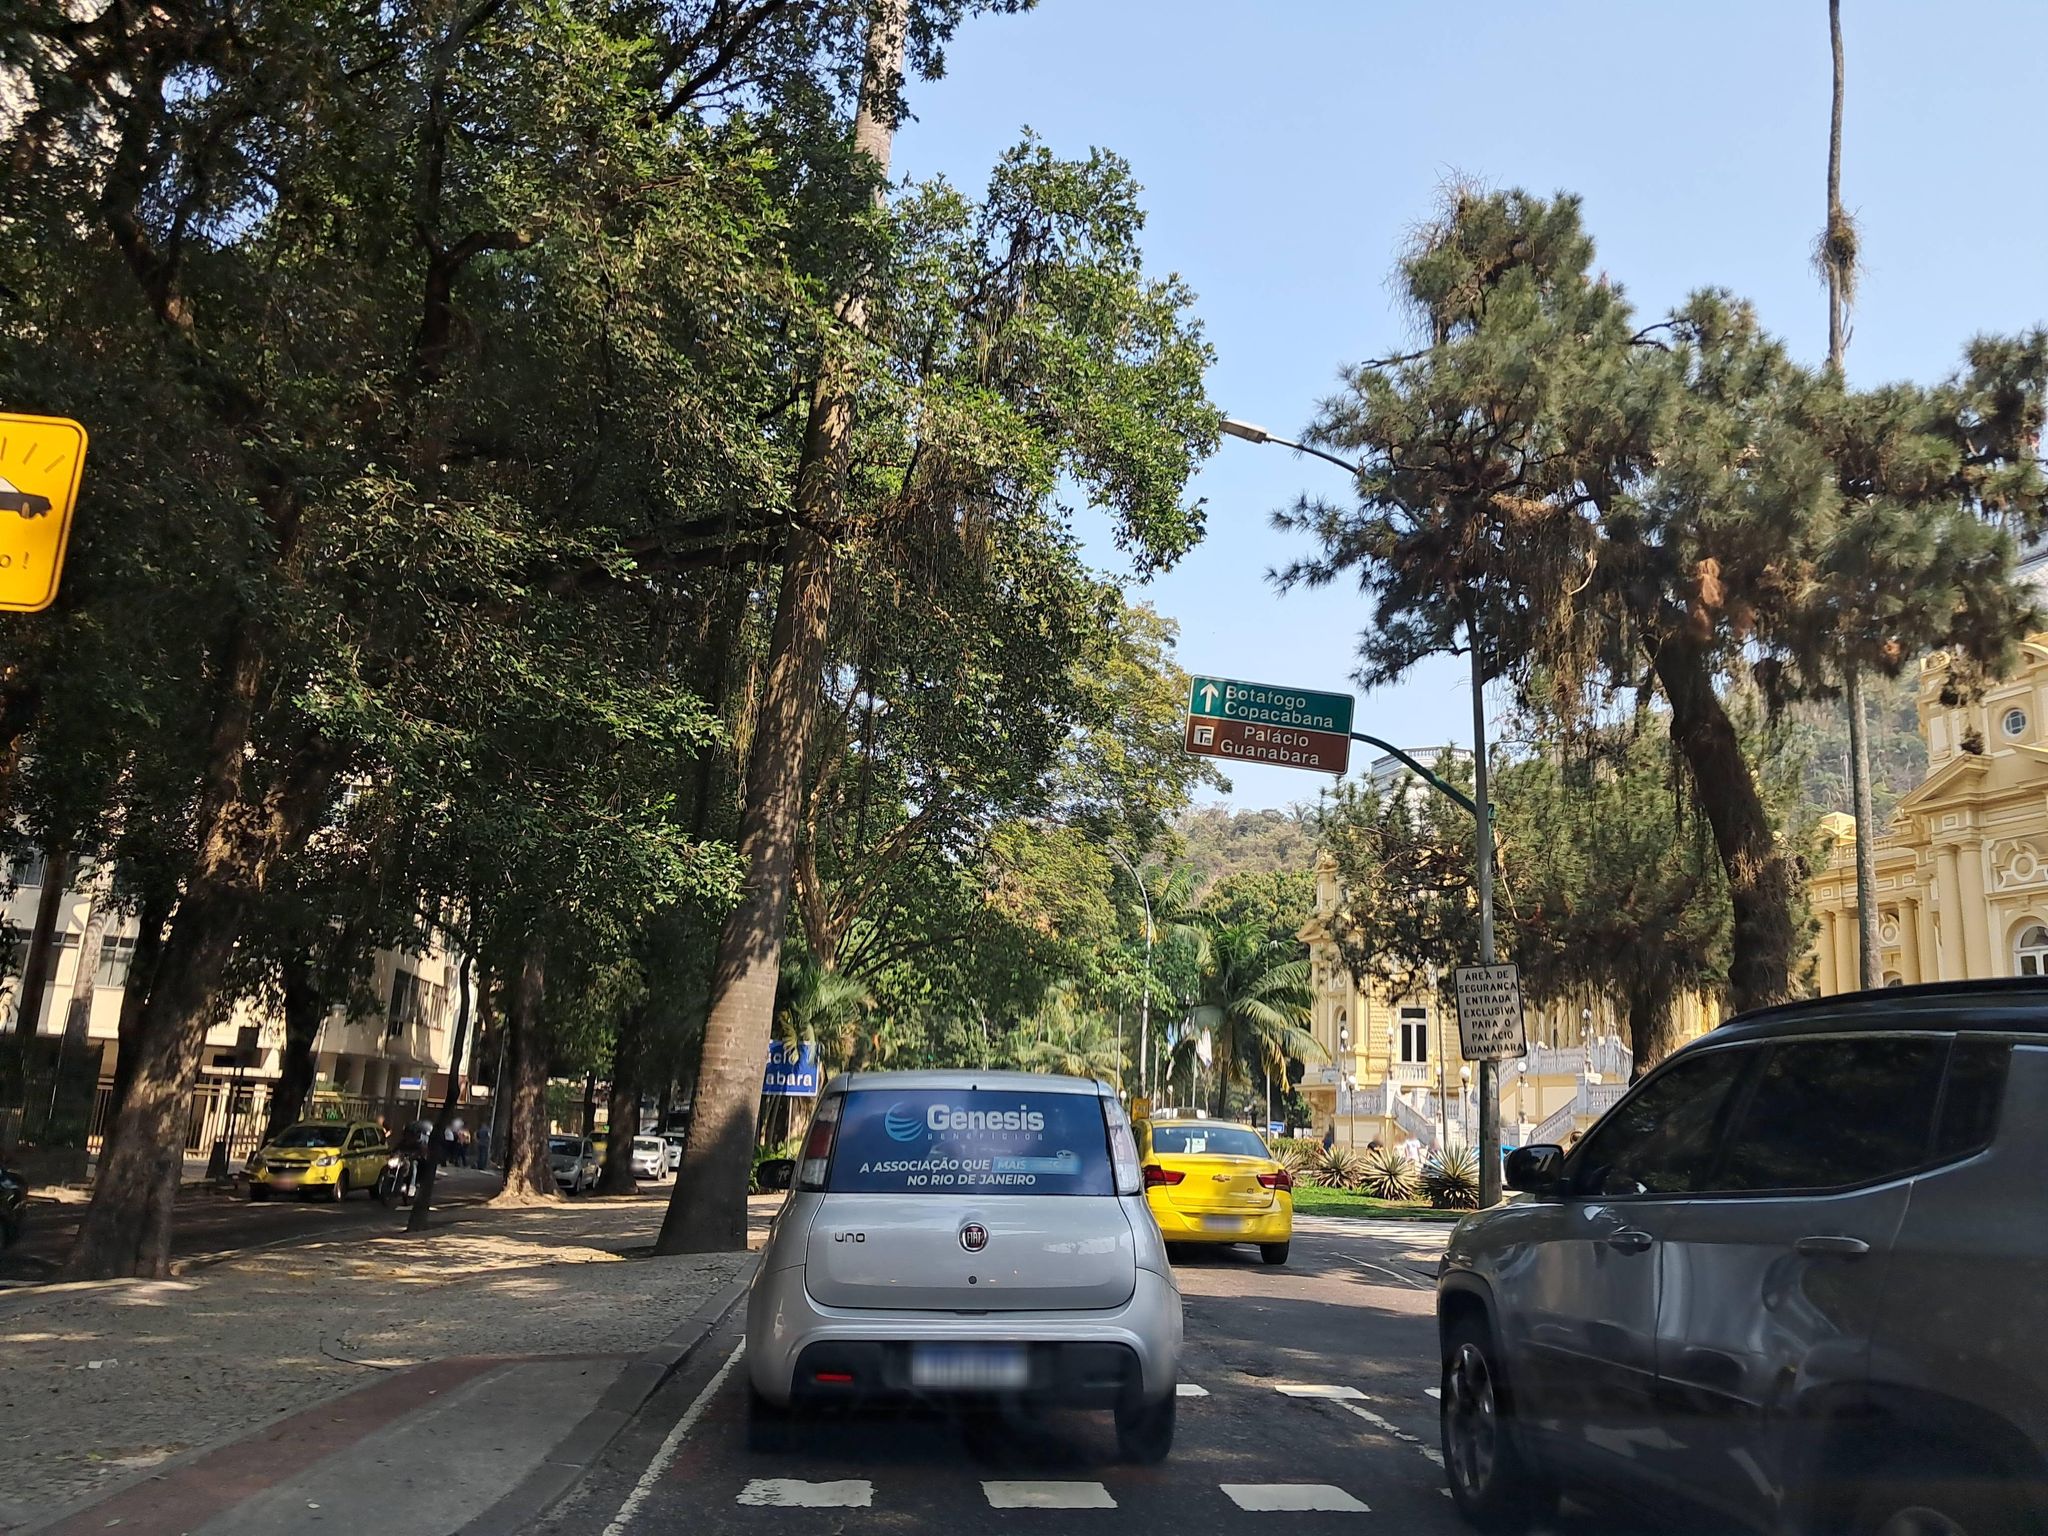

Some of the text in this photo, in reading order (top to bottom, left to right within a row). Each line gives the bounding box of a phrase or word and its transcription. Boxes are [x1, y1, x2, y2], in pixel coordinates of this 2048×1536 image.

[1225, 686, 1306, 710] Botafogo
[1224, 702, 1334, 728] Copacabana
[1244, 726, 1309, 747] Palácio
[1220, 739, 1320, 765] Guanabara
[1496, 970, 1508, 979] DE
[1466, 995, 1511, 1005] ENTRADA
[1464, 1006, 1516, 1018] EXCLUSIVA
[1472, 1018, 1511, 1029] PARA O
[1464, 1043, 1523, 1054] GUANABARA
[927, 1104, 1045, 1131] Genesis
[859, 1162, 870, 1173] A
[873, 1157, 959, 1173] ASSOCIAÇÃO
[962, 1159, 990, 1172] QUE
[998, 1160, 1026, 1170] MAIS
[907, 1173, 1036, 1186] NO RIO DE JANEIRO
[967, 1232, 981, 1244] FIAT
